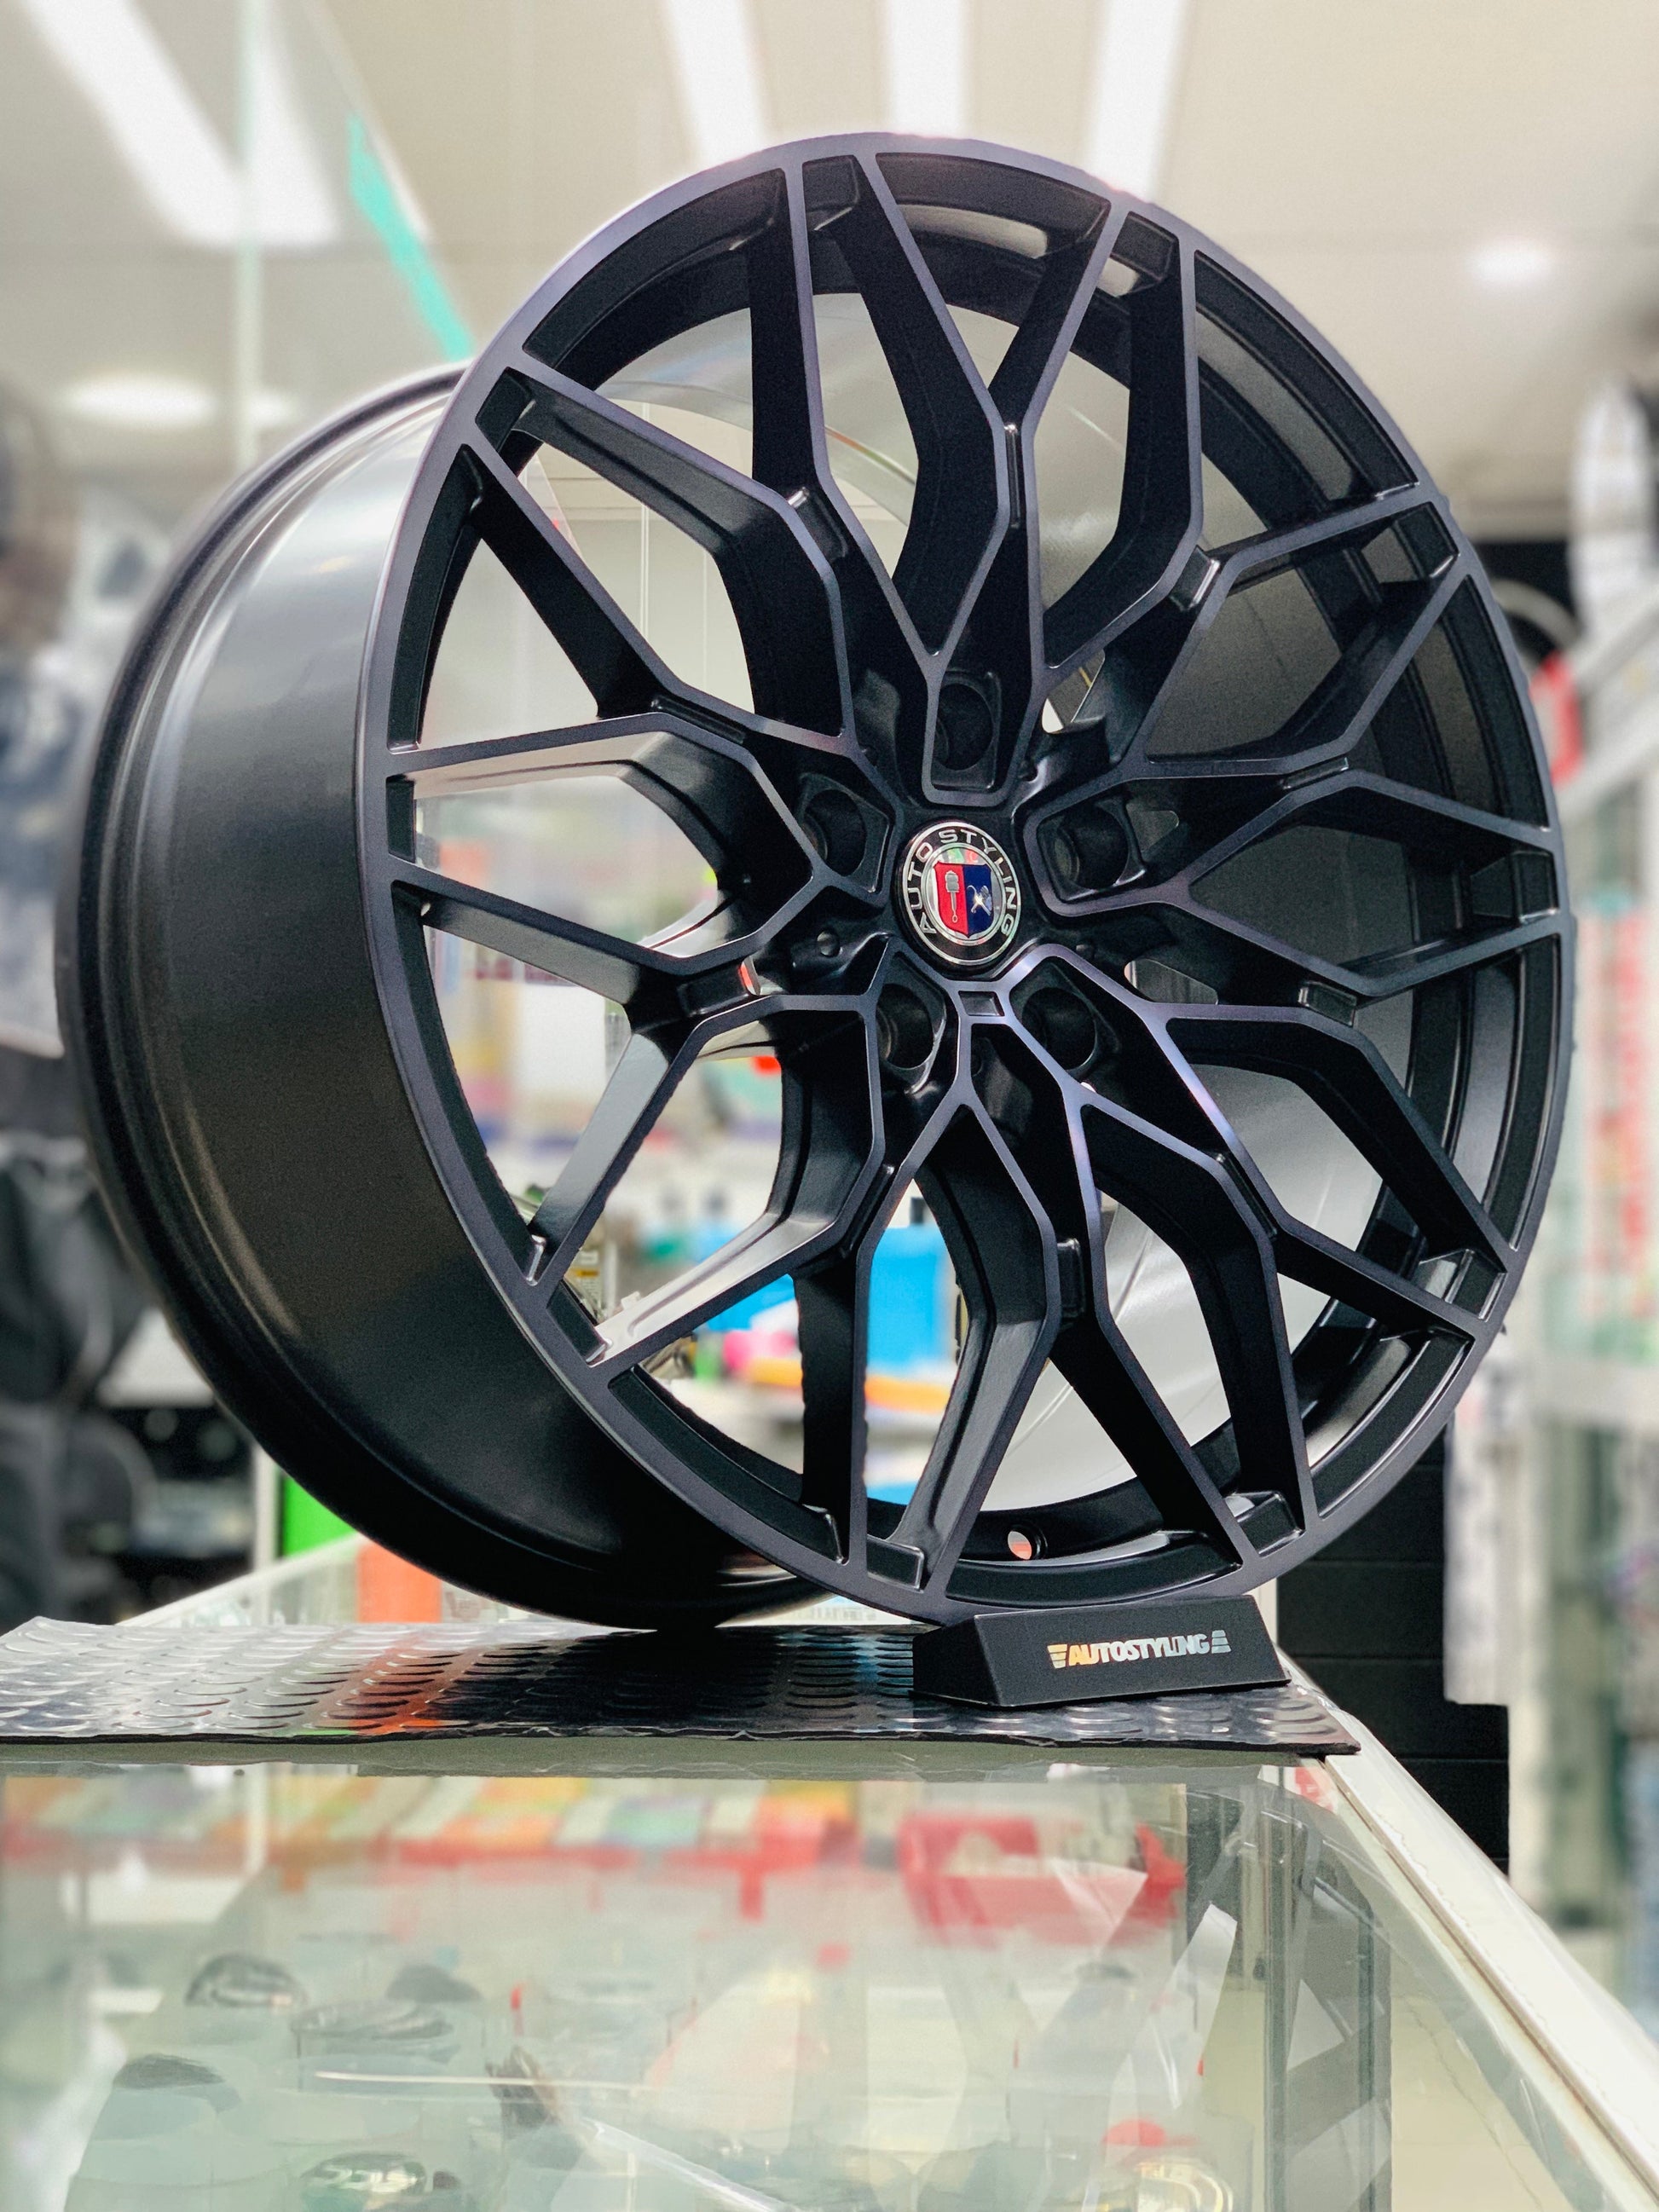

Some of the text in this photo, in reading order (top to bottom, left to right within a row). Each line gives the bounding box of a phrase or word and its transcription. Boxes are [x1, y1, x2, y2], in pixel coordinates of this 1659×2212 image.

[907, 829, 1017, 937] AUTO STYLING
[1068, 1633, 1211, 1666] AUTOSTYLING
